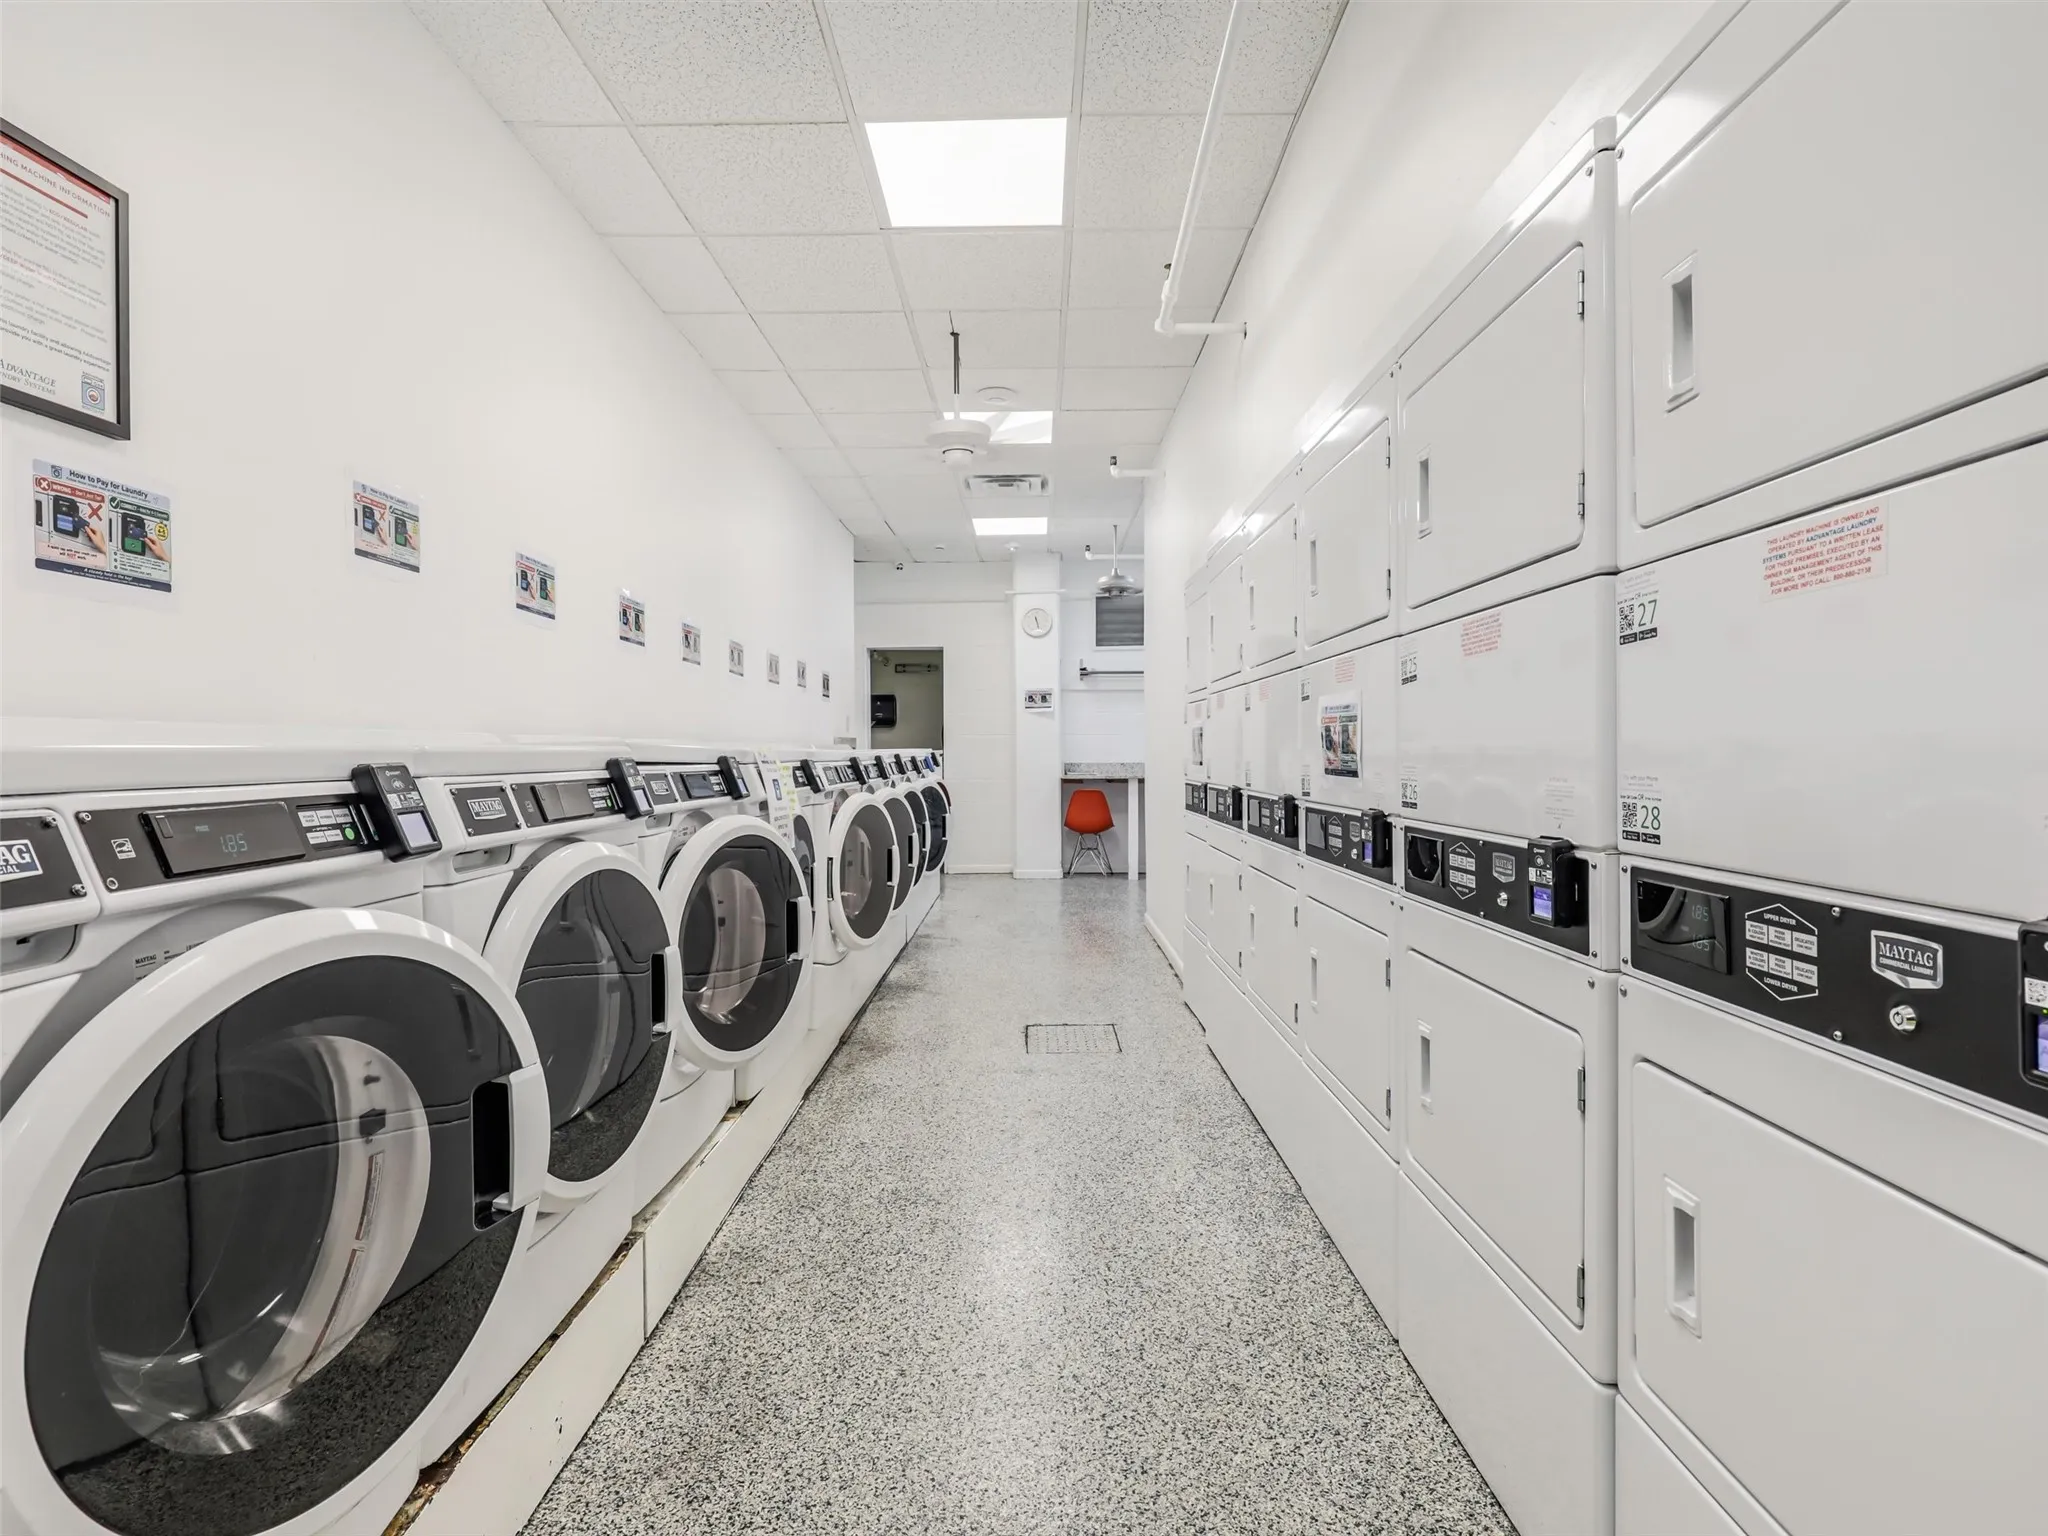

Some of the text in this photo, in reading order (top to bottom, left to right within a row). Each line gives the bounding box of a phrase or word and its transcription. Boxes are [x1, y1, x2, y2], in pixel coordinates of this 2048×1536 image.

[21, 163, 57, 189] MACHINE
[60, 185, 110, 217] INFORMATION
[69, 469, 149, 500] How to Pay for Laundry
[1779, 530, 1805, 544] LAUNDRY
[1806, 521, 1832, 534] MACHINE
[1840, 512, 1864, 524] OWNED
[1865, 506, 1880, 516] AND
[1762, 552, 1786, 565] SYSTEMS
[1787, 543, 1817, 557] PURSUANT
[1833, 531, 1861, 544] WRITTEN
[1862, 524, 1884, 536] LEASE
[1768, 542, 1796, 554] OPERATED
[1805, 526, 1845, 543] AADVANTAGE
[1846, 517, 1877, 531] LAUNDRY
[1765, 563, 1776, 571] FOR
[1776, 558, 1794, 568] THESE
[1826, 541, 1860, 555] EXECUTED
[1860, 538, 1869, 546] BY
[1871, 535, 1880, 543] AN
[1763, 571, 1782, 581] OWNER
[1793, 557, 1833, 573] MANAGEMENT
[1834, 551, 1855, 562] AGENT
[1867, 544, 1882, 553] THIS
[1798, 573, 1806, 581] OR
[1807, 567, 1824, 577] THEIR
[1825, 557, 1871, 573] PREDECESSOR
[1771, 587, 1782, 595] FOR
[1783, 583, 1799, 593] MORE
[1800, 580, 1814, 589] INFO
[1637, 599, 1657, 627] 27
[1409, 784, 1418, 800] 26
[471, 798, 503, 813] MAYTAG
[1640, 805, 1661, 830] 28
[1750, 923, 1764, 931] WHITES
[1763, 912, 1797, 926] UPPER DRYER
[1751, 929, 1766, 937] COLORS
[1794, 937, 1815, 946] DELICATES
[135, 953, 157, 965] MAYTAG
[1750, 950, 1764, 958] WHITES
[1752, 956, 1766, 964] COLORS
[1878, 942, 1934, 967] MAYTAG
[1795, 966, 1815, 976] DELICATES
[1879, 957, 1934, 976] COMMERCIAL LAUNDRY
[1764, 976, 1798, 993] LOWER DRYER
